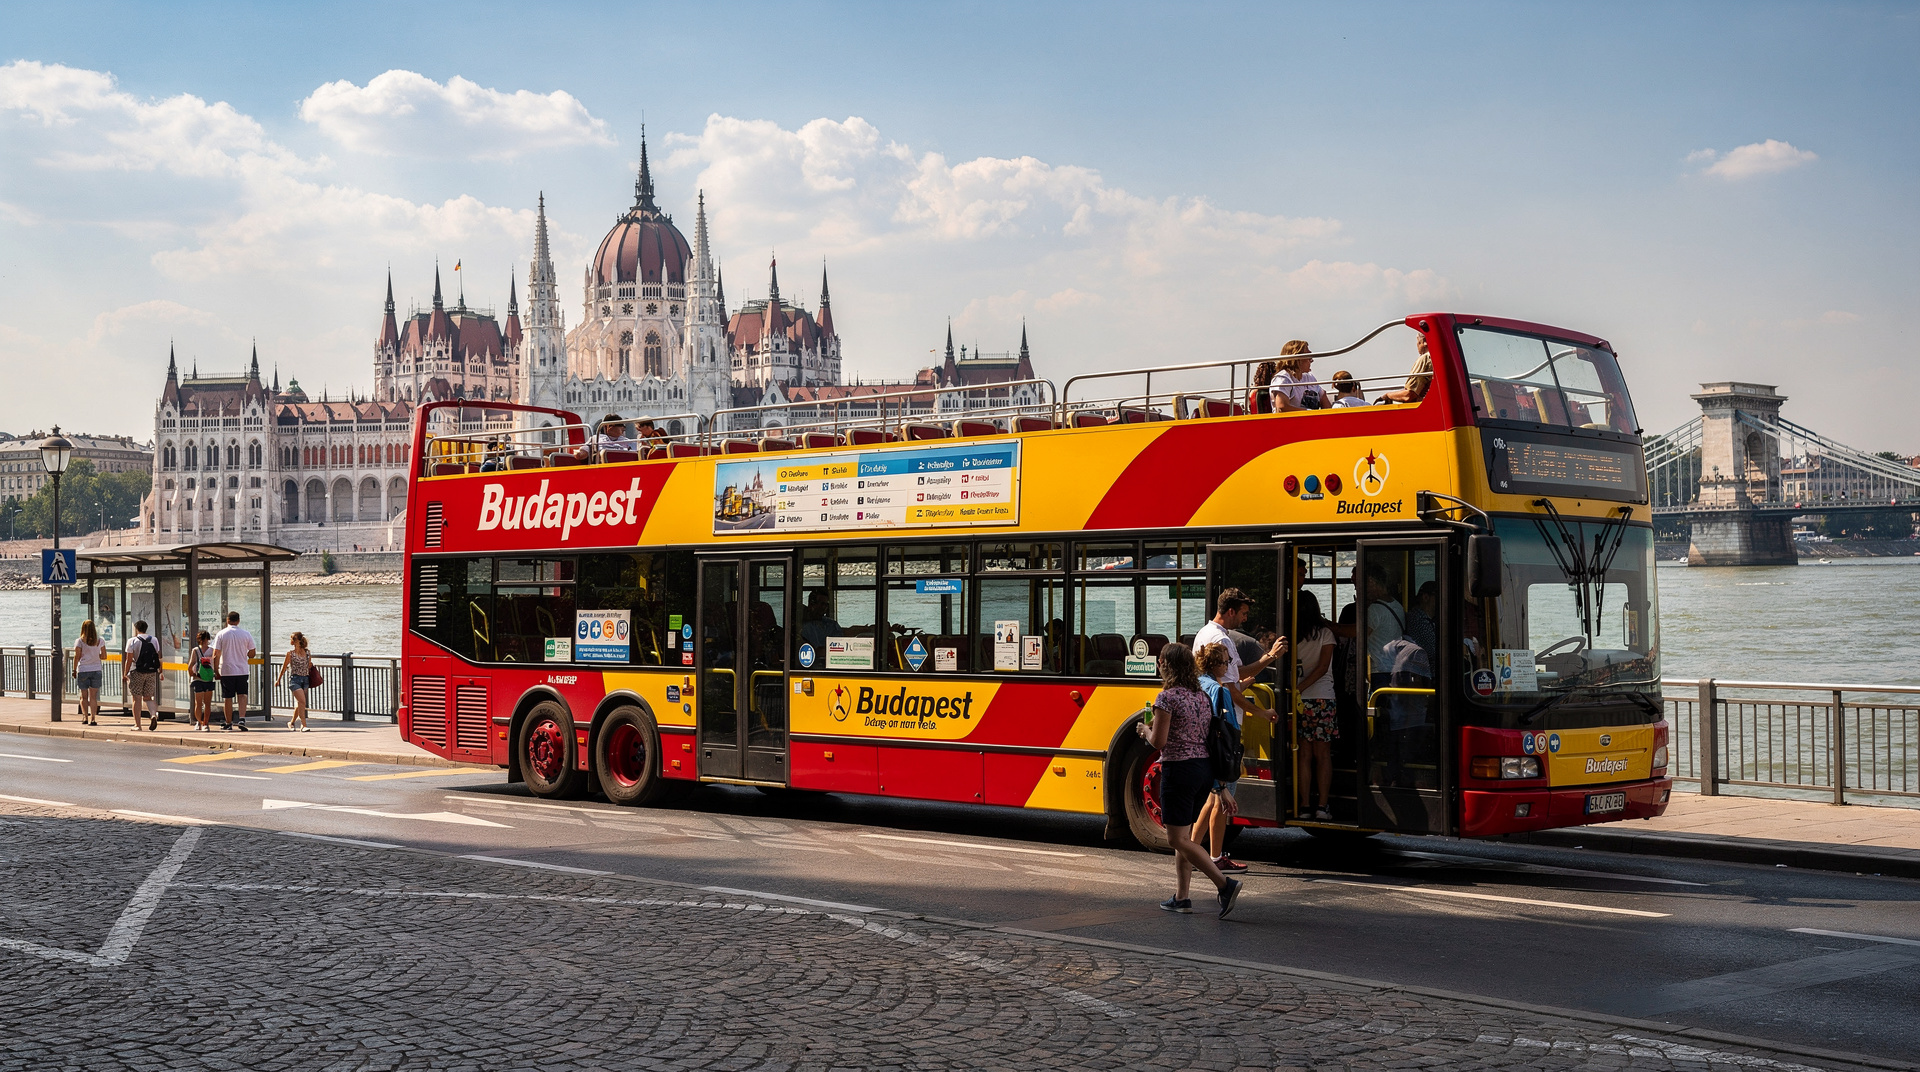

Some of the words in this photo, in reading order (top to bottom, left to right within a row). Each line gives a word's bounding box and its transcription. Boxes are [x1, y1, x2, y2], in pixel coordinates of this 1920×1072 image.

[477, 477, 642, 541] Budapest
[1336, 499, 1403, 517] Budapest
[856, 686, 973, 722] Budapest
